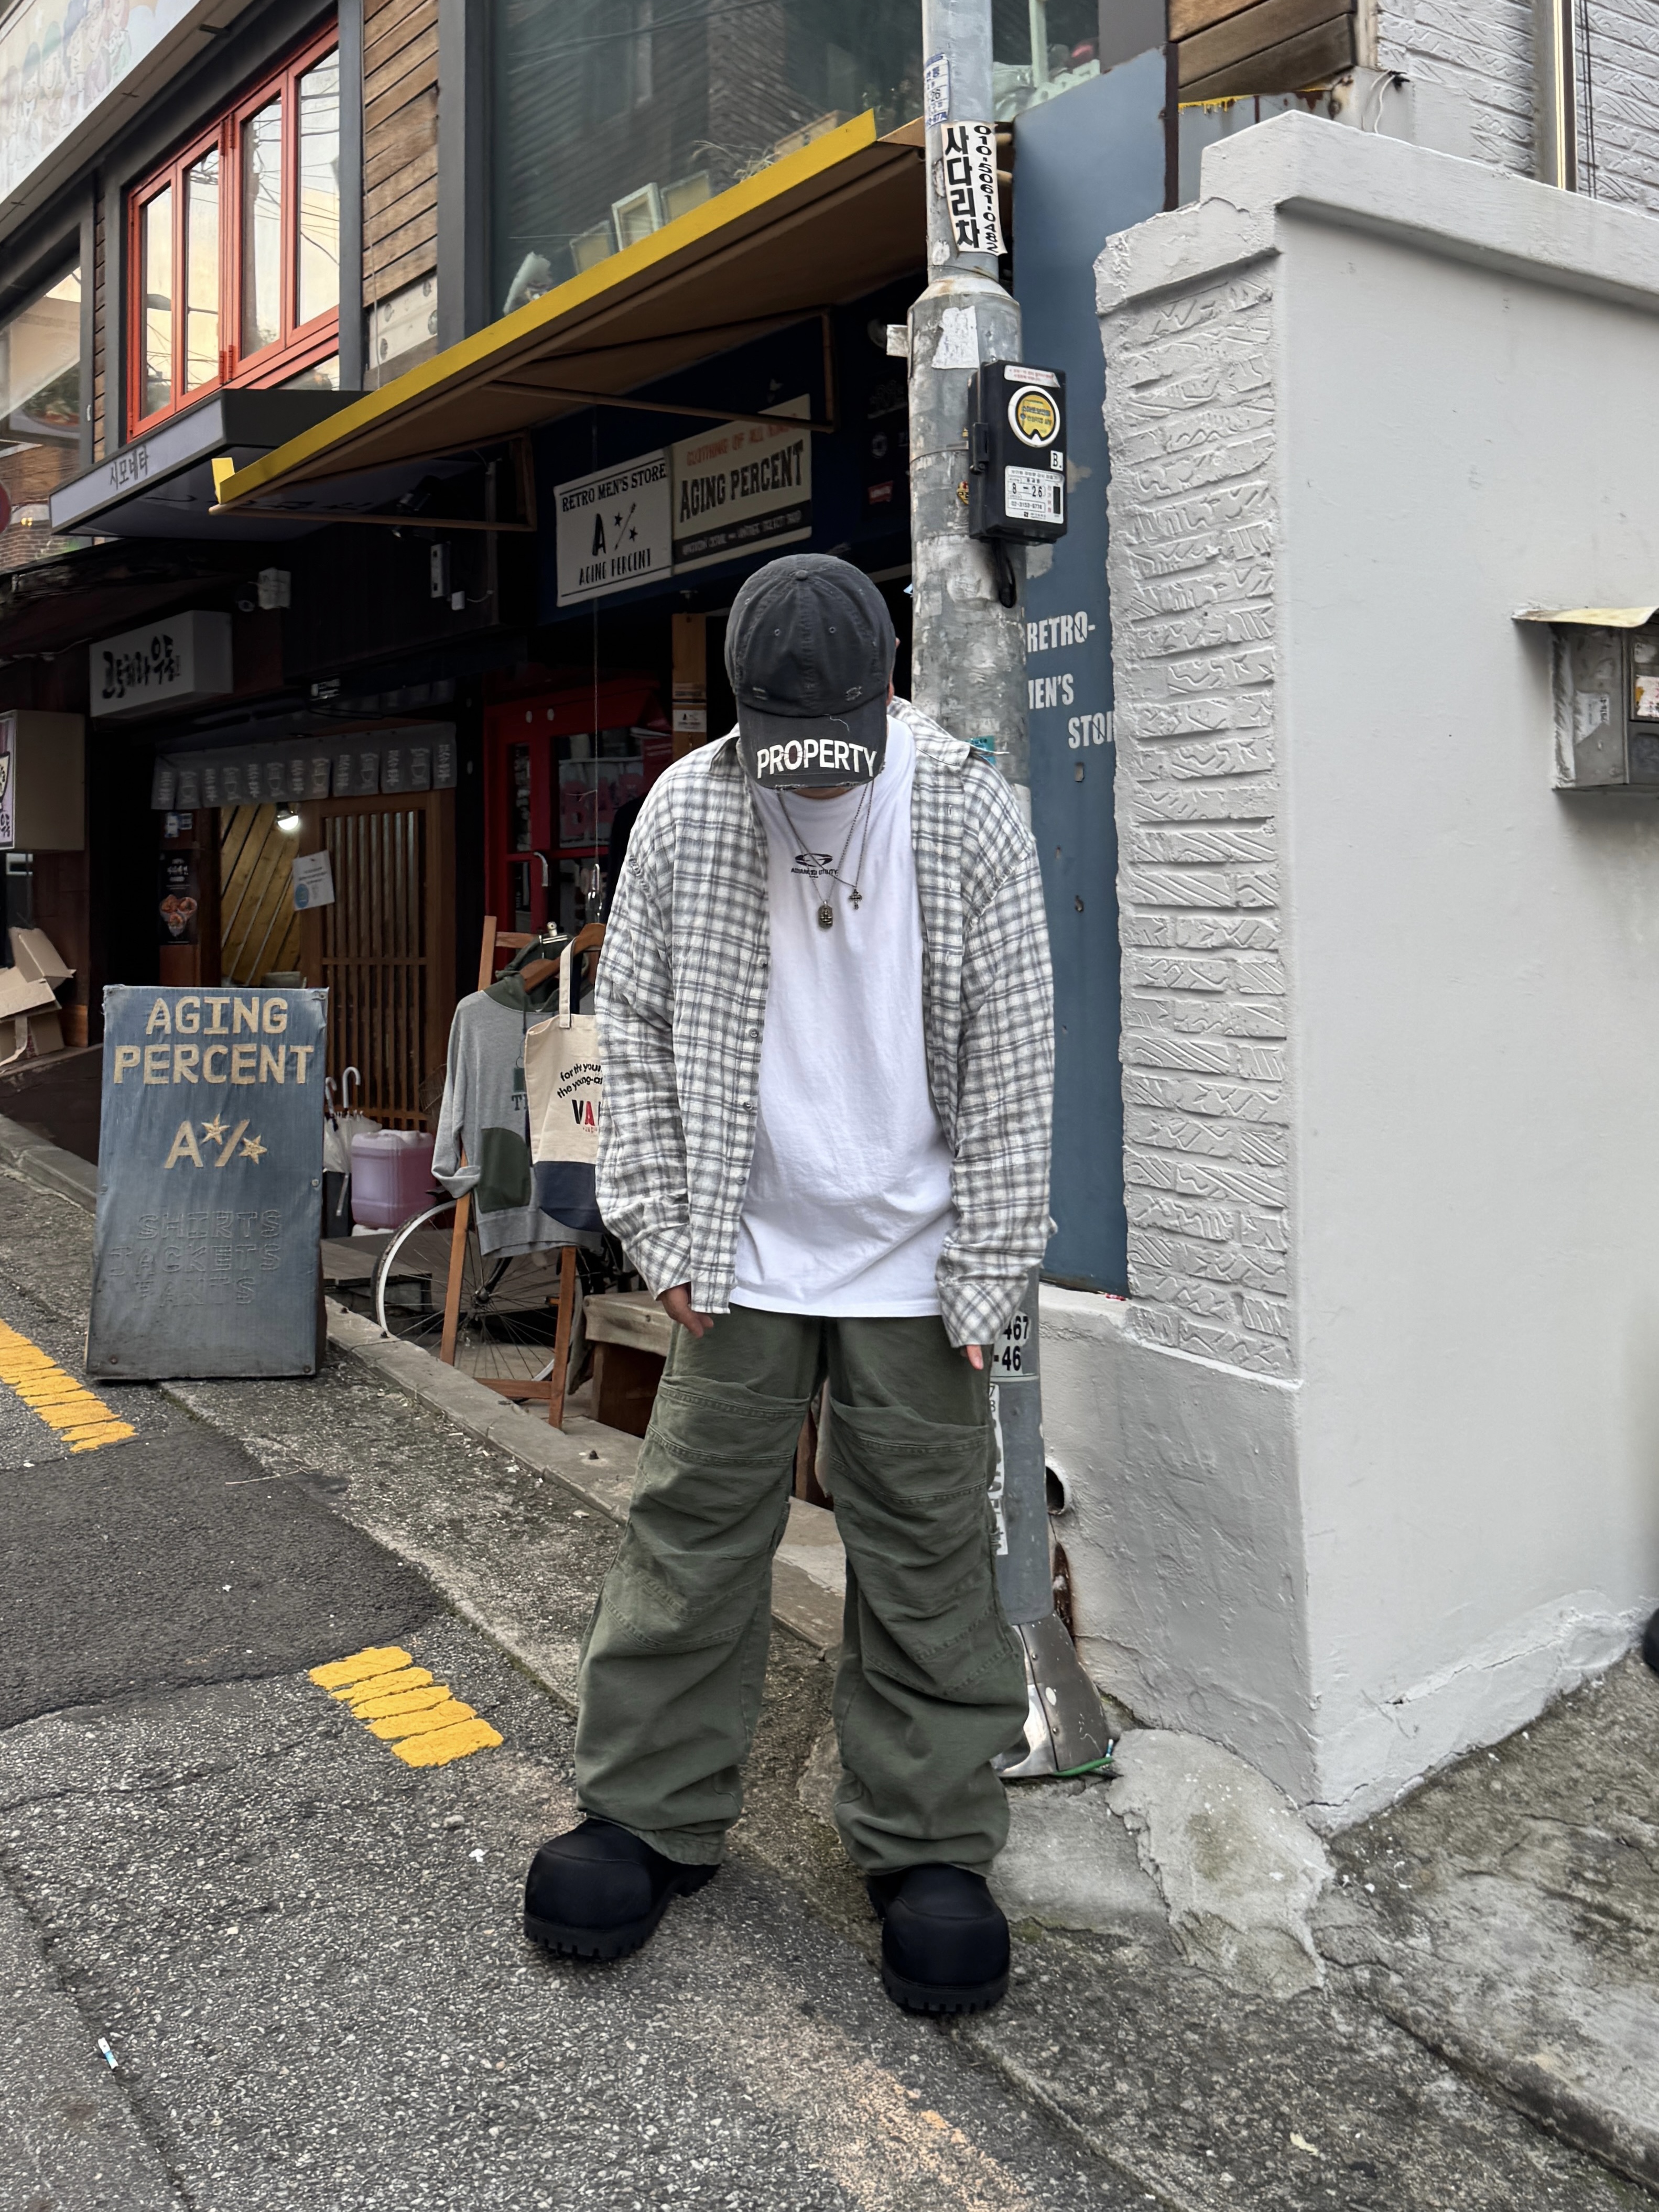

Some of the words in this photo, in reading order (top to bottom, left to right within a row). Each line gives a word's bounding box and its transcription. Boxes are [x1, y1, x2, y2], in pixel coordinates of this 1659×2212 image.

[945, 126, 980, 248] 사다리차
[562, 488, 595, 513] RETRO
[598, 476, 628, 500] MEN'S
[631, 463, 667, 488] STORE
[680, 473, 726, 523] AGING
[731, 439, 804, 500] PERCENT
[579, 561, 606, 585] AGING
[611, 548, 651, 577] PERCENT
[757, 739, 877, 779] PROPERTY
[146, 996, 288, 1035] AGING
[113, 1043, 315, 1084] PERCENT
[560, 1068, 573, 1082] for
[557, 1085, 572, 1098] the
[571, 1099, 601, 1126] VA
[137, 1209, 281, 1240] SHIRTS
[108, 1243, 281, 1276] JACKETS
